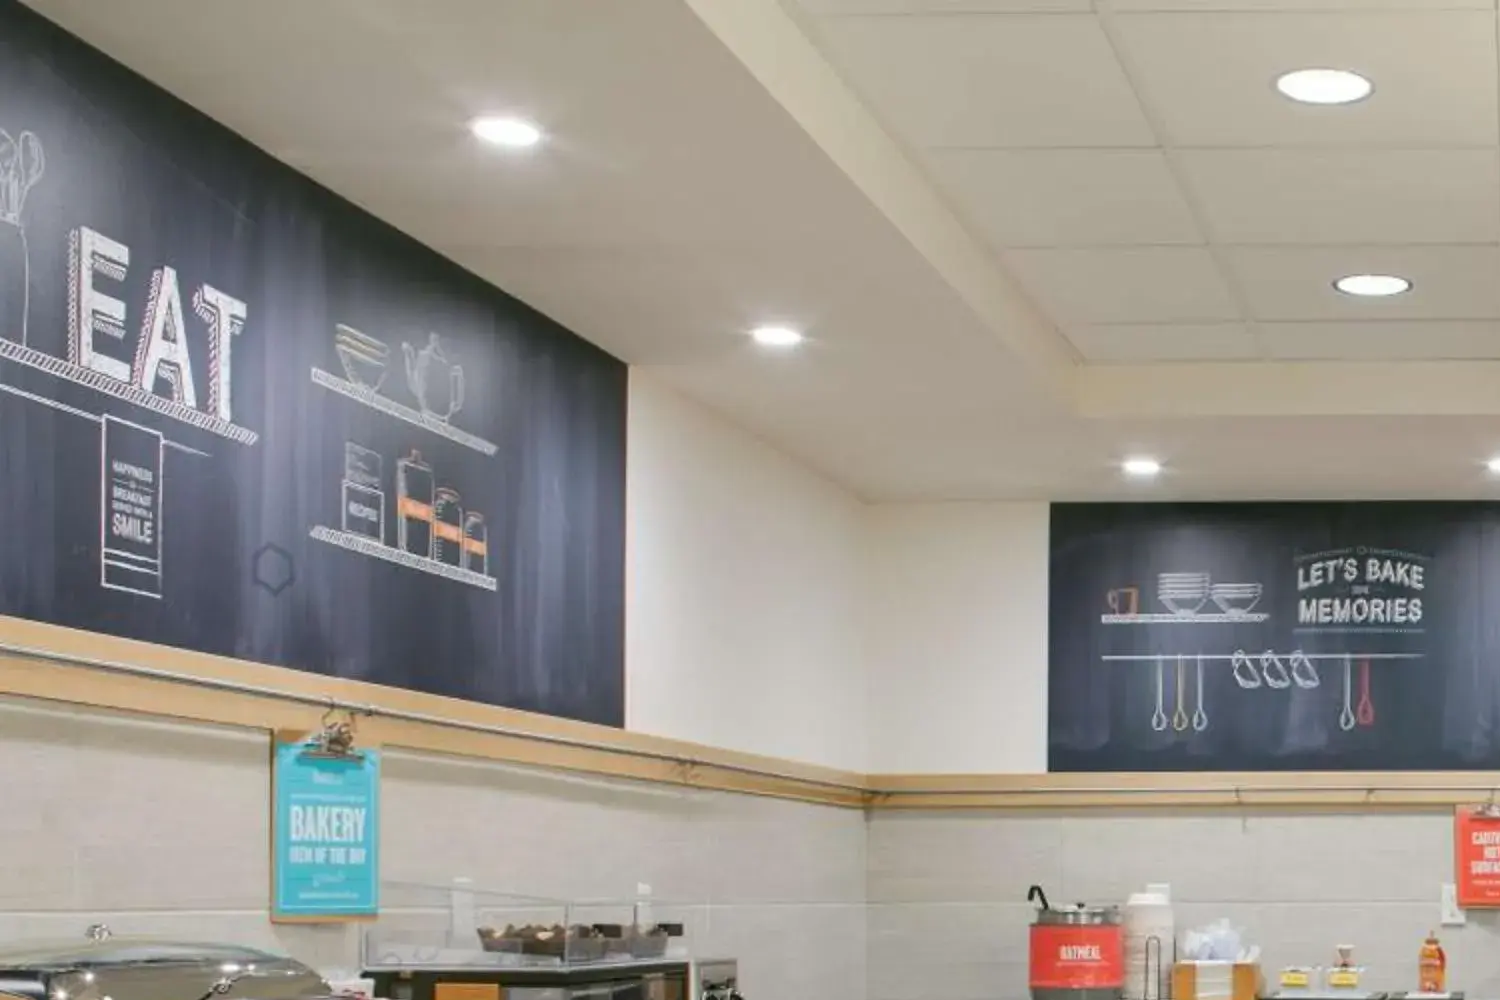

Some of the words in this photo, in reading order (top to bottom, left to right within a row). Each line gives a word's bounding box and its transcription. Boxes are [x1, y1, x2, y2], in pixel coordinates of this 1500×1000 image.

[66, 225, 247, 422] EAT
[112, 512, 153, 544] SMILE
[1297, 557, 1358, 591] LET'S
[1365, 557, 1425, 591] BAKE
[1297, 598, 1423, 624] MEMORIES
[288, 804, 366, 843] BAKERY
